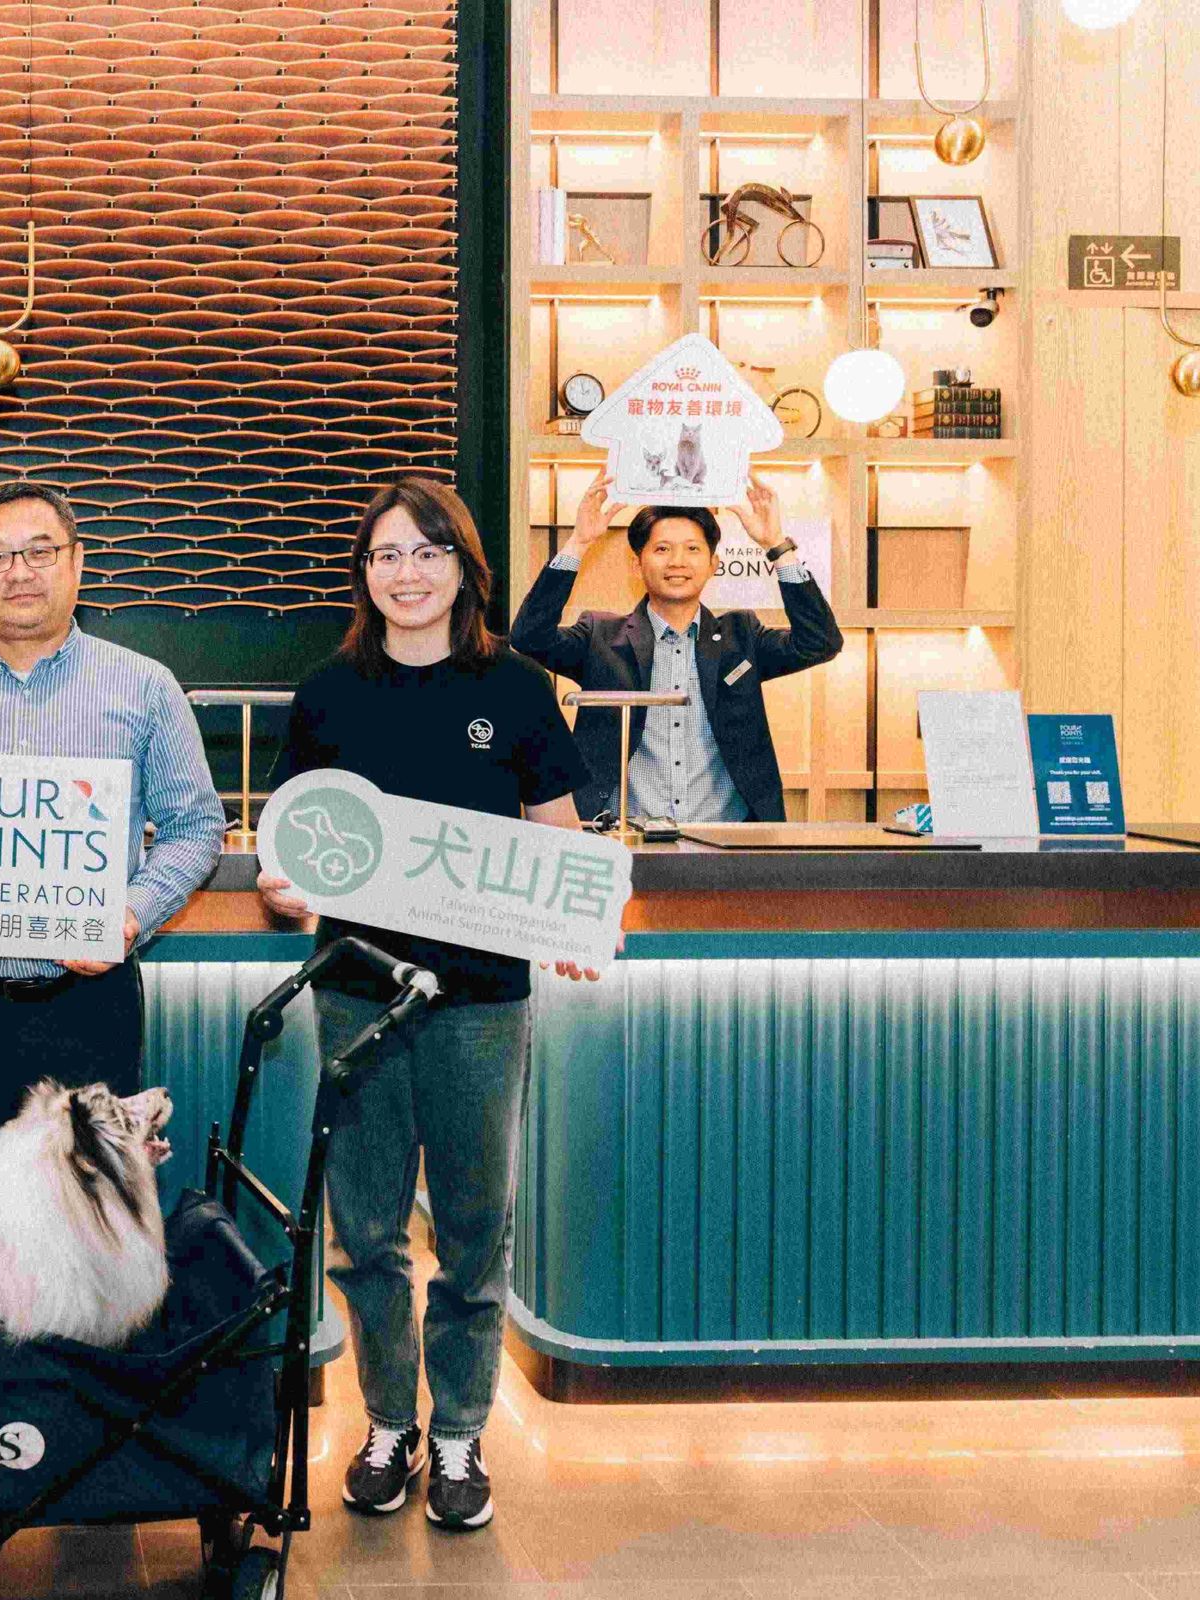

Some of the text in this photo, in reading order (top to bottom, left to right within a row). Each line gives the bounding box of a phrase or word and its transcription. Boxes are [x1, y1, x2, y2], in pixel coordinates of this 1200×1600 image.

[651, 382, 722, 393] ROYAL CANIN
[627, 399, 742, 417] 寵物友善環境
[725, 547, 763, 557] MARR
[713, 560, 776, 577] BONV
[404, 821, 615, 921] 犬山居
[439, 896, 568, 933] Taiwan Companion
[407, 906, 592, 955] Animal Support Association
